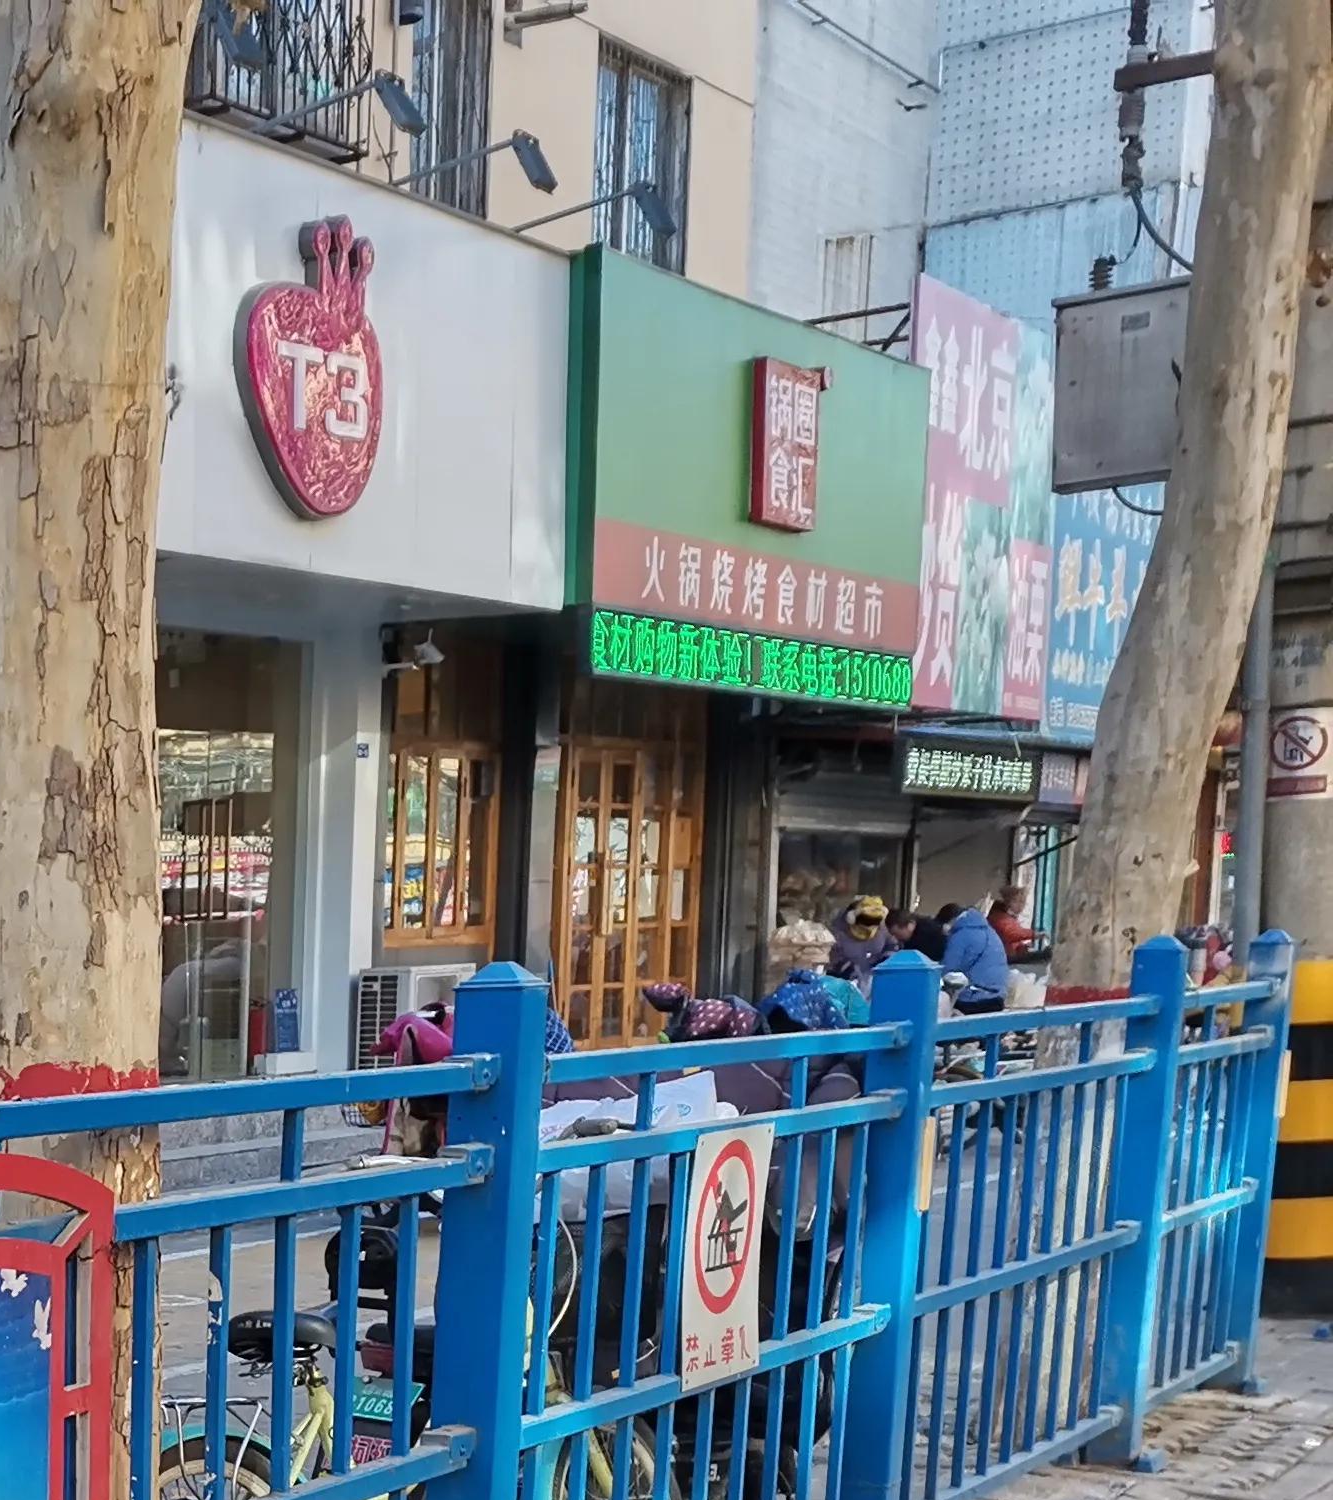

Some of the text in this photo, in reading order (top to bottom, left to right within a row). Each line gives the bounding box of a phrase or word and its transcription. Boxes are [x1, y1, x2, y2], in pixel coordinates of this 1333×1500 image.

[277, 339, 369, 439] T3
[641, 536, 884, 640] 火锅烧烤食材超市
[352, 1394, 394, 1415] 1068
